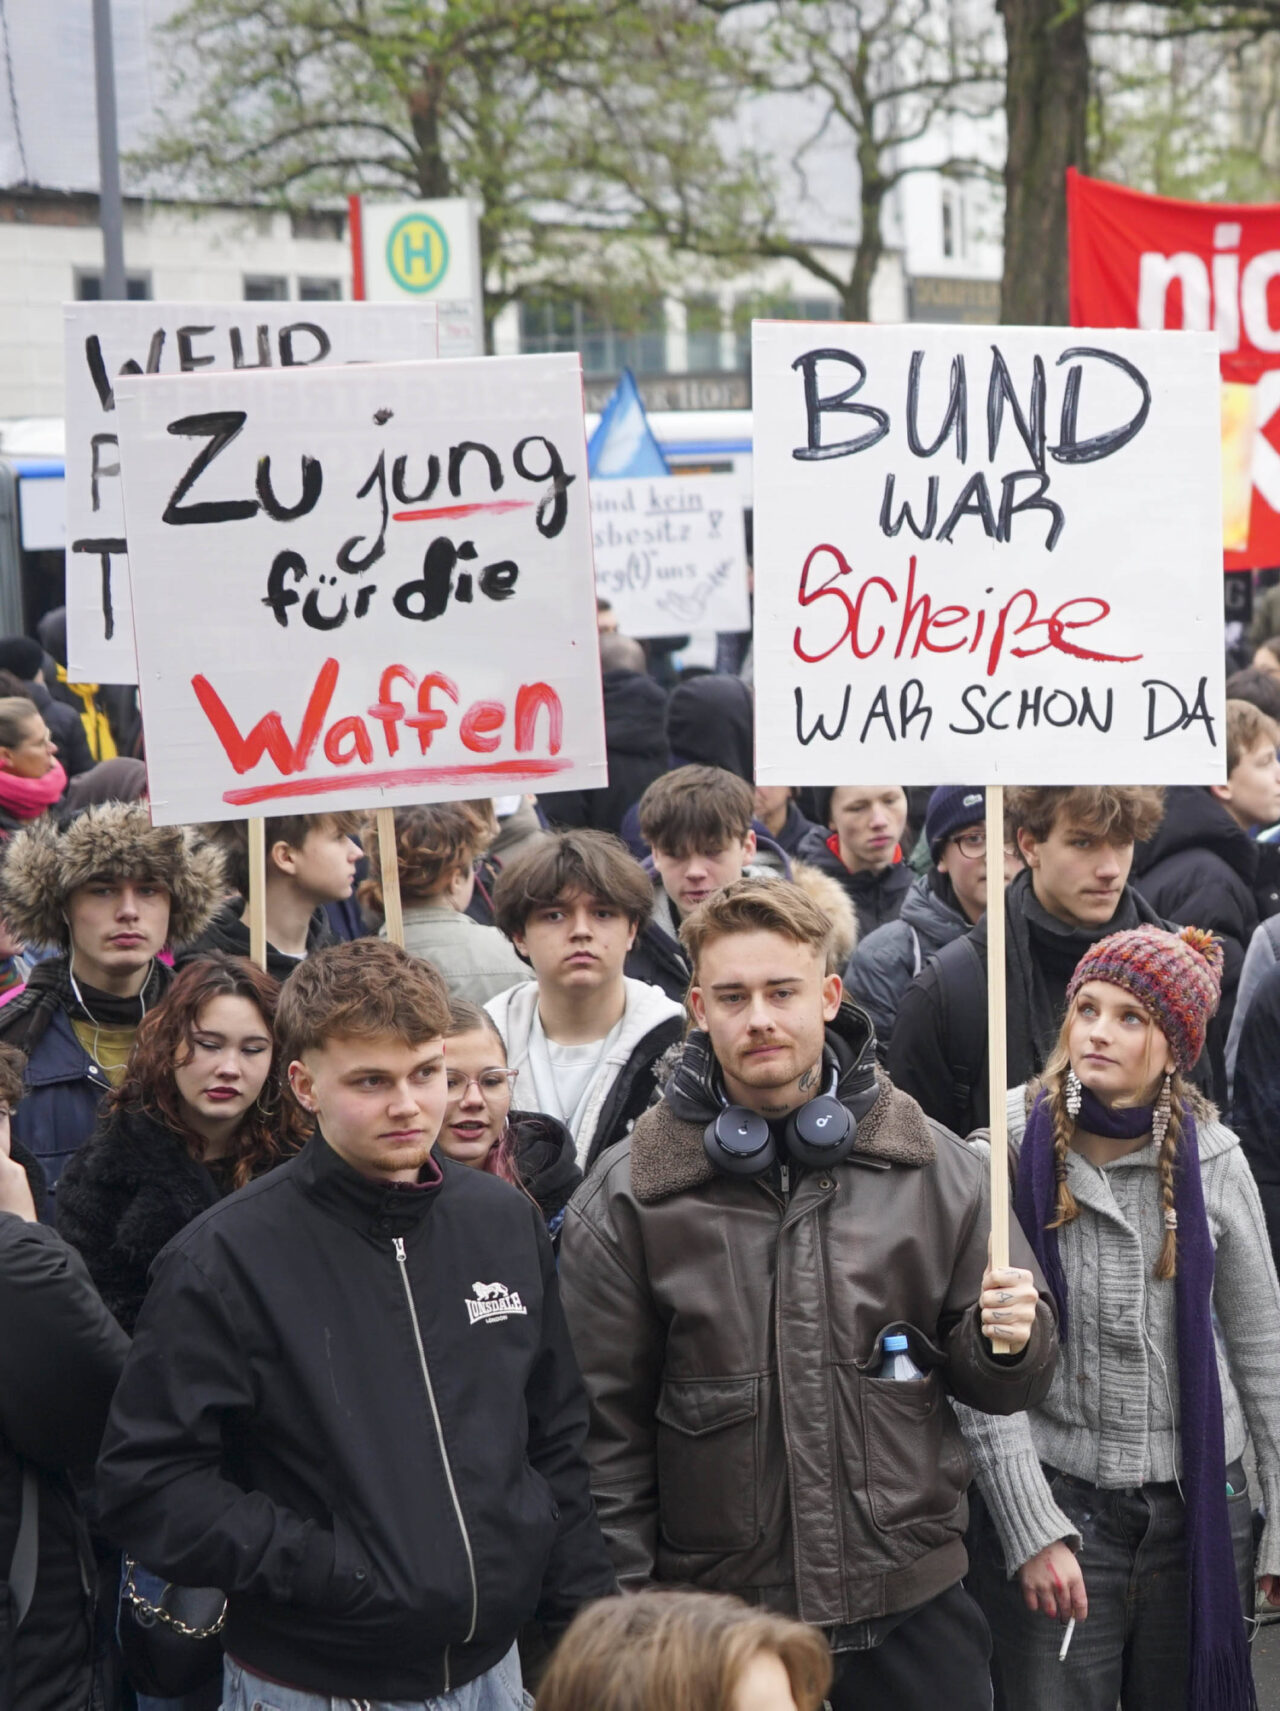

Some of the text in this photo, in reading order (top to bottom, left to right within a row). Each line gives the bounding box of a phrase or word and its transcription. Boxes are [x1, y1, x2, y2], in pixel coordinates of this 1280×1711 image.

[403, 232, 432, 274] H
[792, 344, 1151, 471] BUND
[162, 407, 576, 575] Zu jung
[879, 468, 1065, 551] WAR
[261, 535, 519, 631] für die
[793, 543, 1144, 676] Scheiße
[190, 657, 564, 776] Waffen
[793, 676, 1217, 747] WAR SCHON DA
[464, 1291, 528, 1325] LONSDALE
